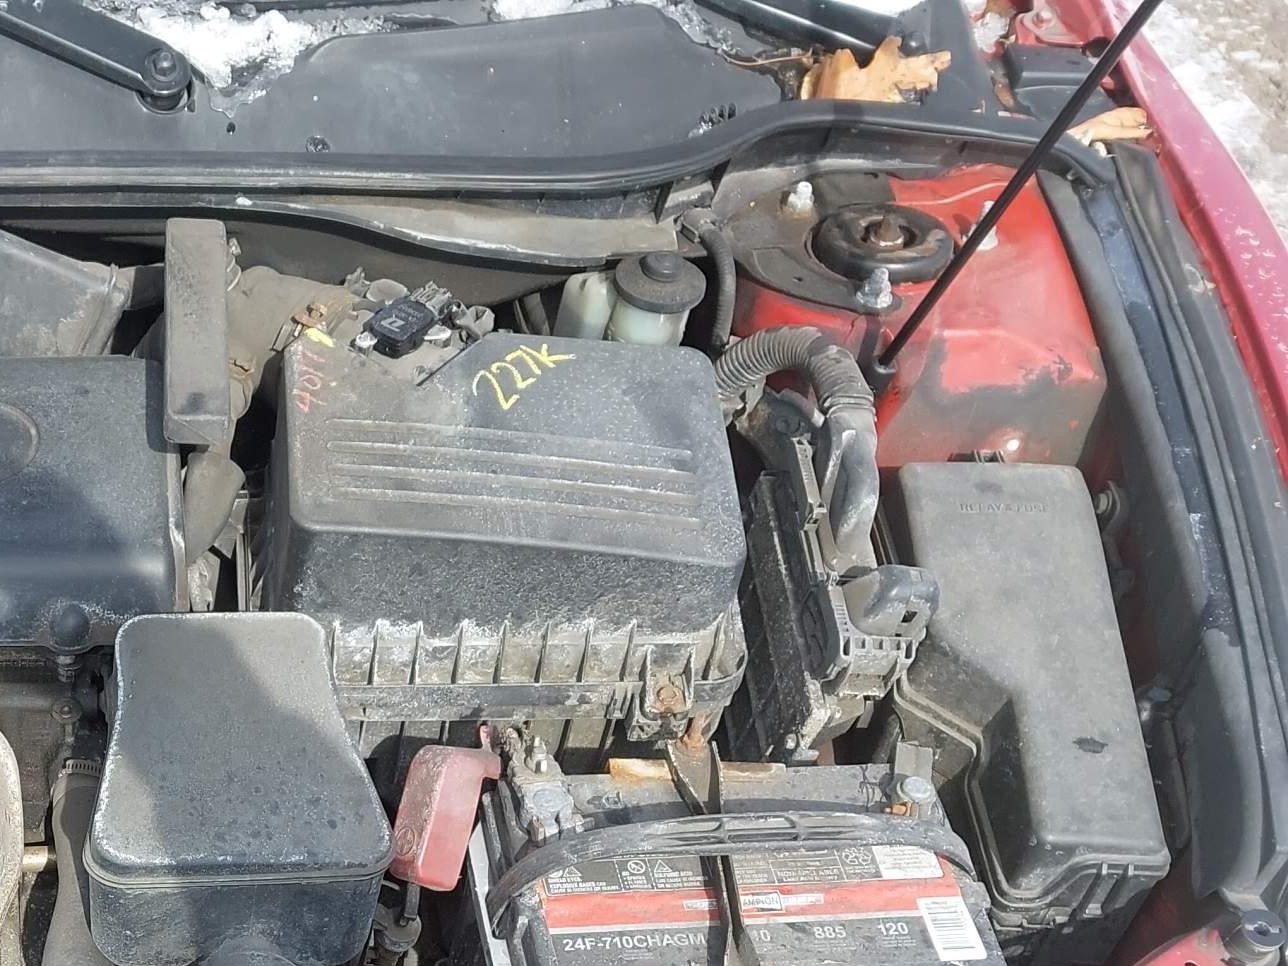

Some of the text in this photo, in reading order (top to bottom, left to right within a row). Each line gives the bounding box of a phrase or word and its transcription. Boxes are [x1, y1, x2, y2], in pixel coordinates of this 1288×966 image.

[472, 343, 576, 410] 227K
[742, 896, 779, 908] AMPION
[562, 932, 707, 951] 24F-710CHAGM
[813, 925, 847, 939] 885
[876, 922, 909, 936] 120
